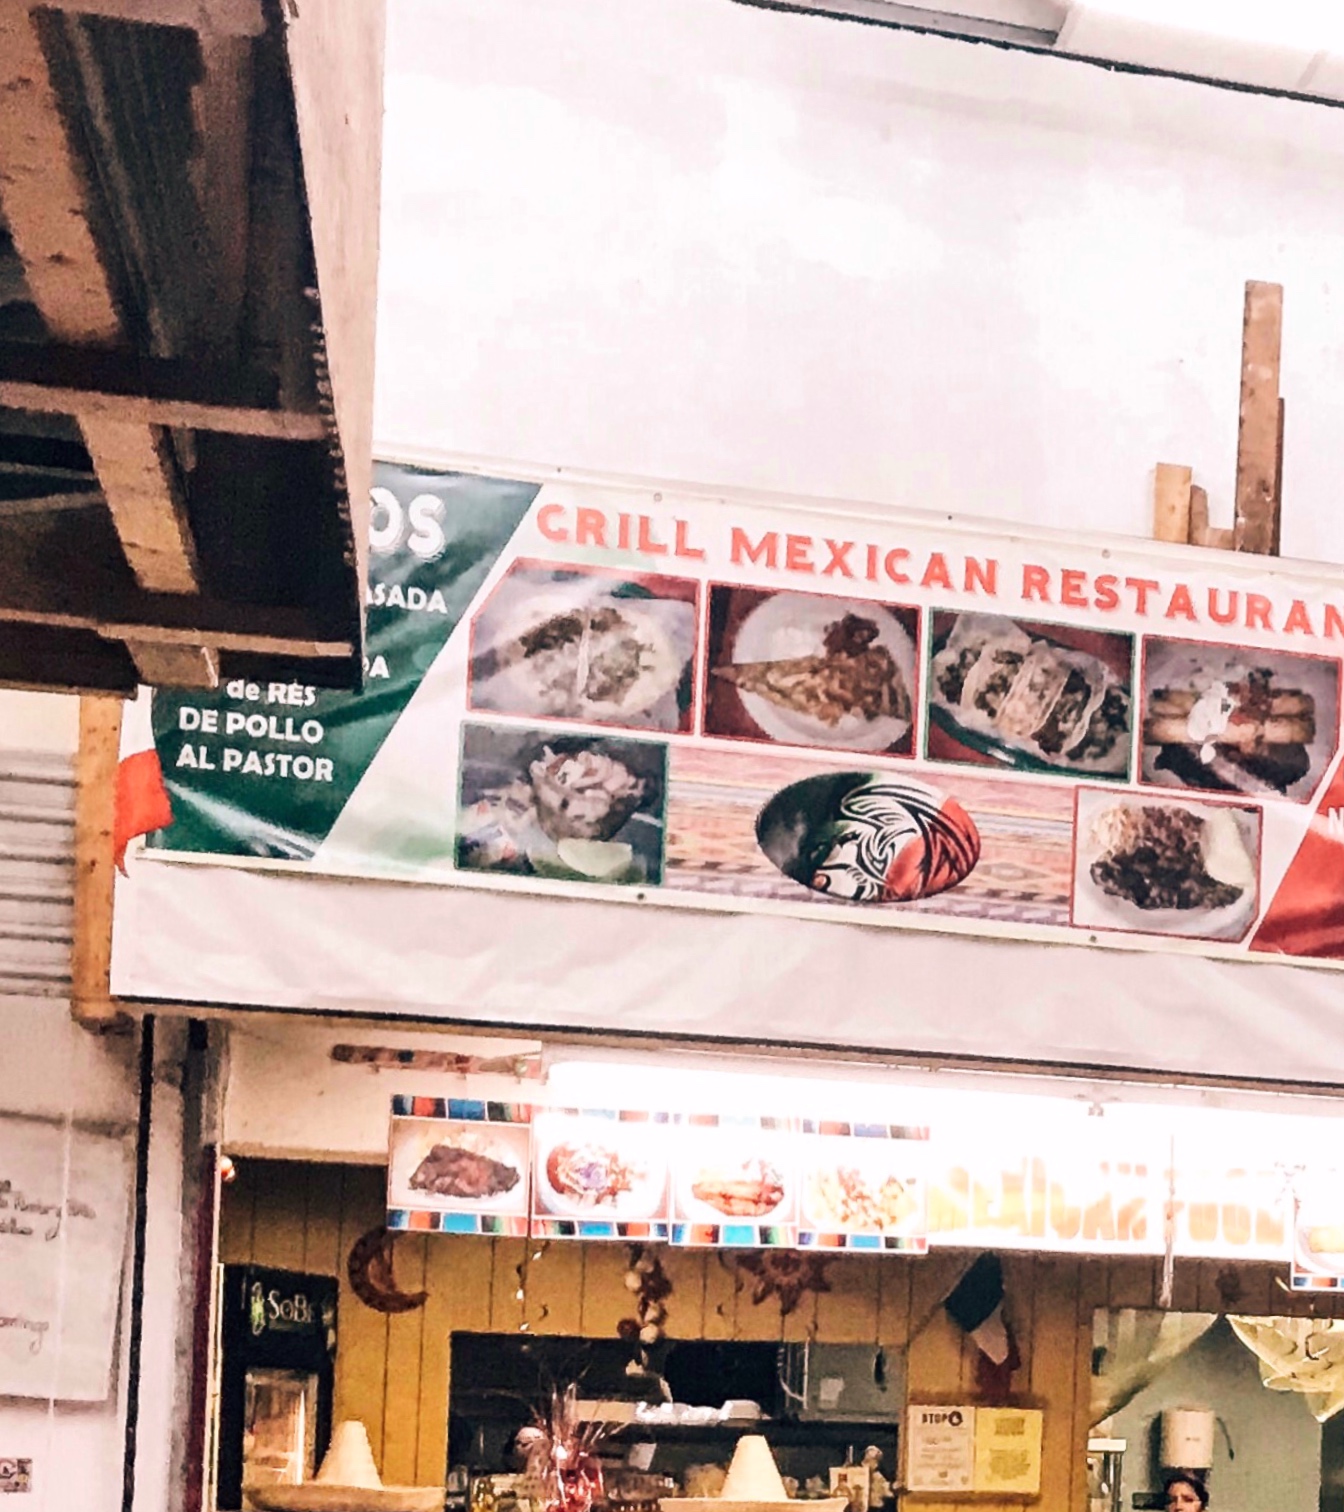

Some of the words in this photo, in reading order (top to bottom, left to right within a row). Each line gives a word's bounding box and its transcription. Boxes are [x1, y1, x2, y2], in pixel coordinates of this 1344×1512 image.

[536, 503, 706, 559] GRILL
[729, 526, 999, 596] MEXICAN
[178, 705, 219, 733] DE
[224, 710, 325, 745] POLLO
[176, 743, 216, 770] AL
[223, 748, 335, 782] PASTOR
